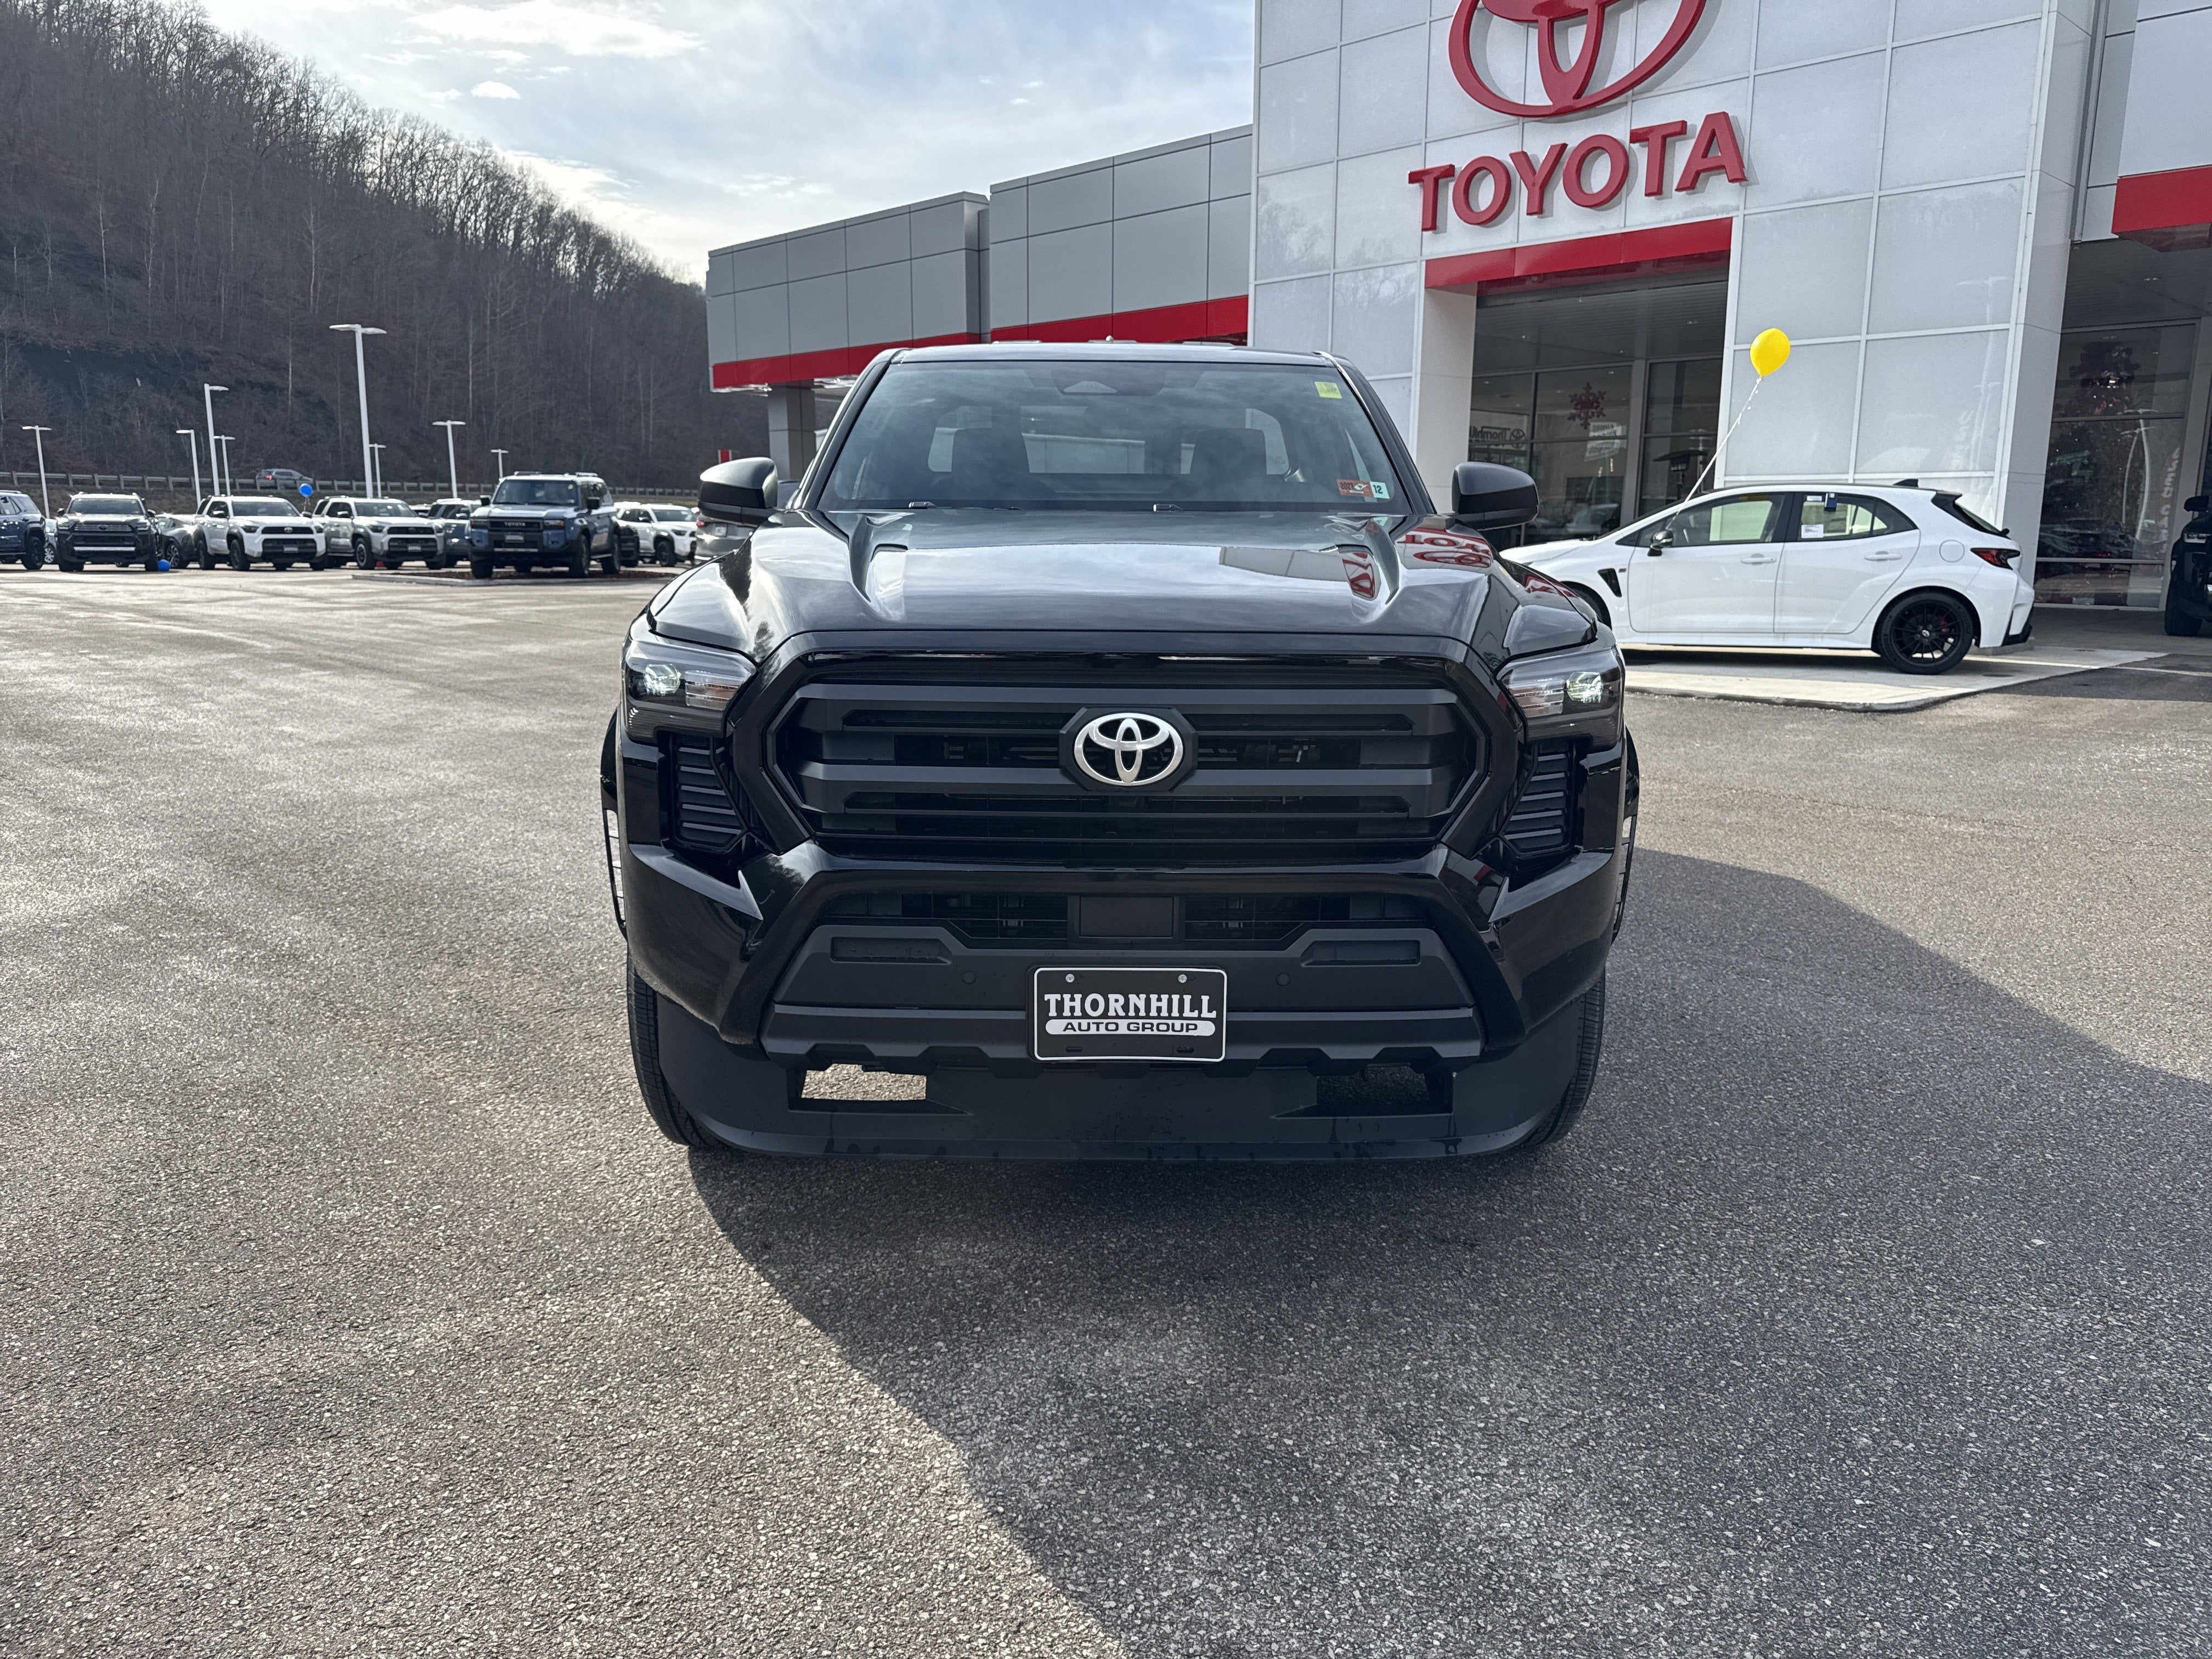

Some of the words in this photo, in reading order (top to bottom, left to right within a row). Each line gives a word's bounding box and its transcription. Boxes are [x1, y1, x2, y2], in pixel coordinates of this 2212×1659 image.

[1408, 112, 1748, 231] TOYOTA
[1373, 484, 1383, 494] 12
[1045, 993, 1216, 1018] THORNHILL
[1063, 1022, 1119, 1032] AUTO
[1127, 1022, 1198, 1032] GROUP
